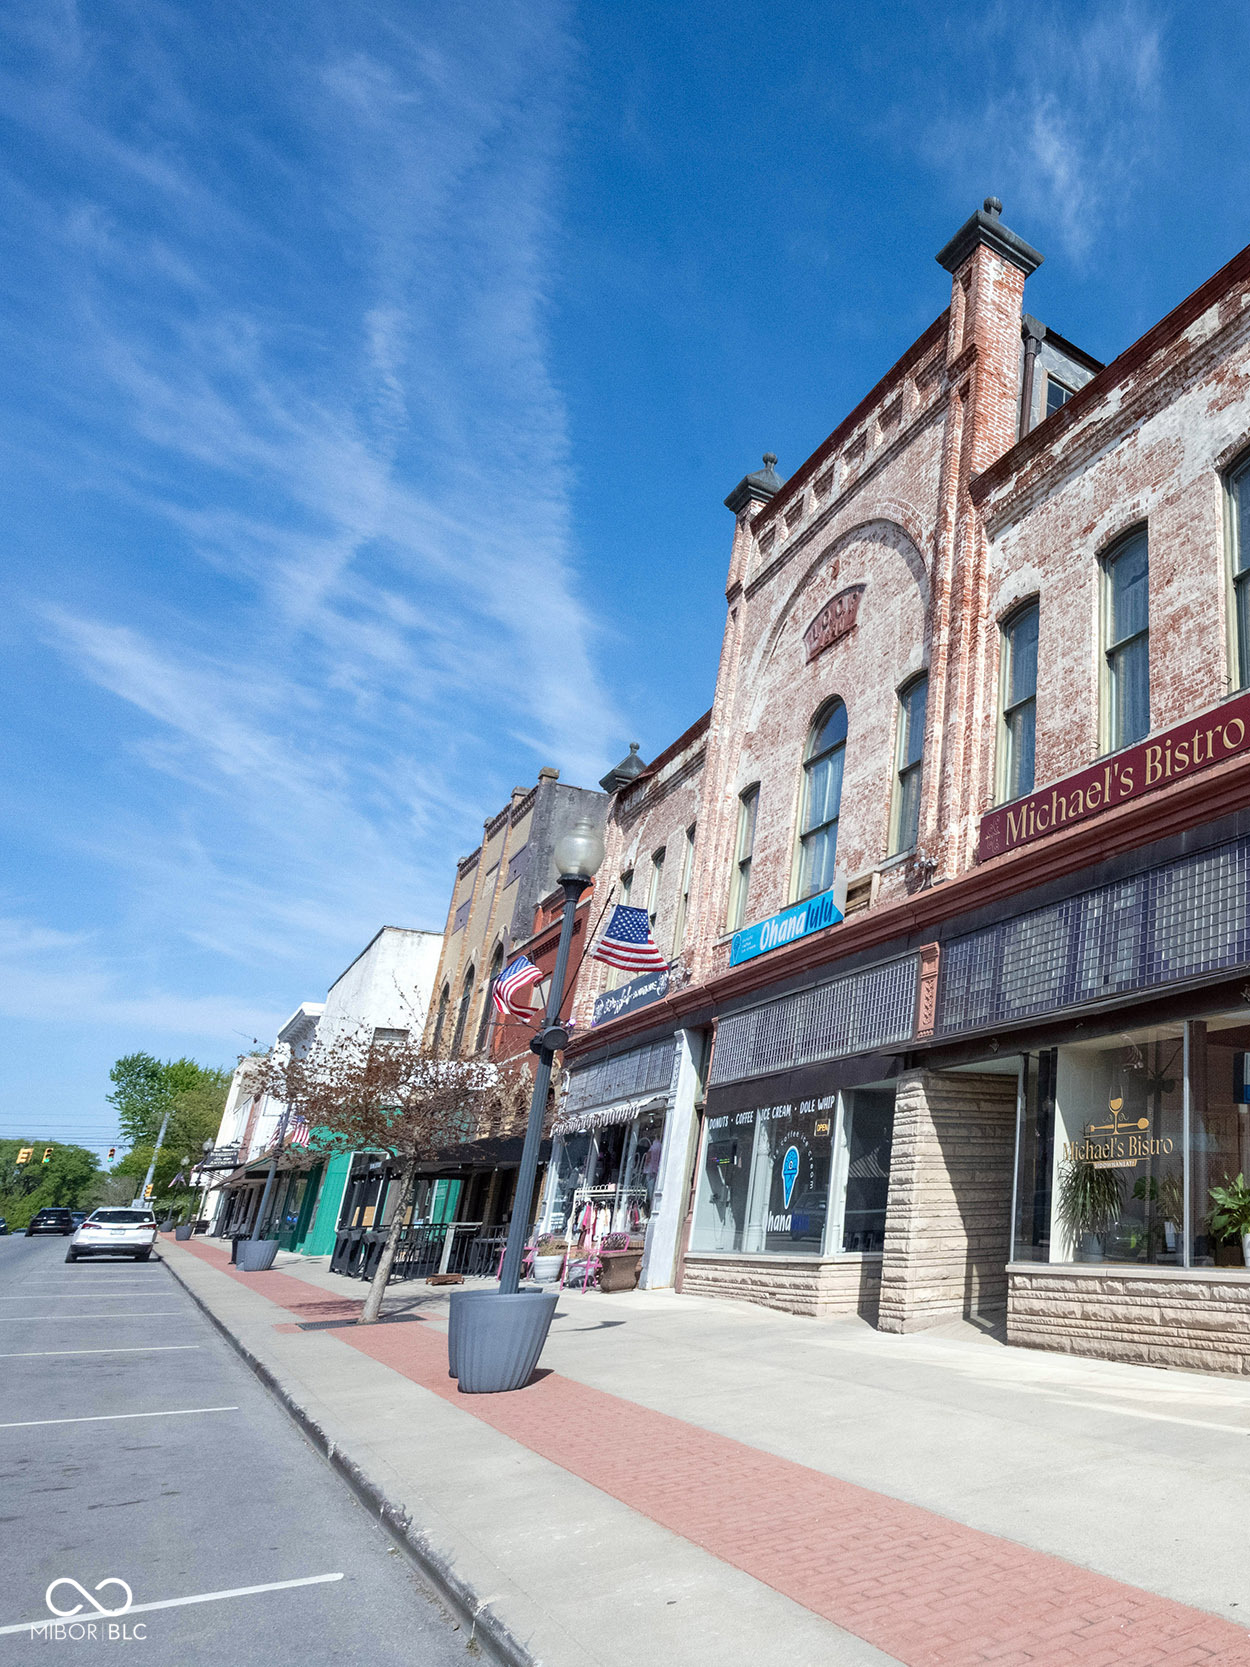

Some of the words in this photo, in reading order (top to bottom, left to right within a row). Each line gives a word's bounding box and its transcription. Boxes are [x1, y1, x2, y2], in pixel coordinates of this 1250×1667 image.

[1005, 762, 1135, 846] Michael's
[1144, 717, 1246, 786] Bistro
[759, 896, 834, 951] Ohanalulu
[708, 1115, 729, 1130] DONUTS
[735, 1111, 754, 1125] COFFEE
[771, 1104, 792, 1119] CREAM
[799, 1099, 816, 1114] DOLE
[817, 1095, 836, 1111] WHIP
[816, 1123, 829, 1132] OPEN
[1063, 1137, 1125, 1161] Michael's
[1128, 1135, 1174, 1157] Bistro
